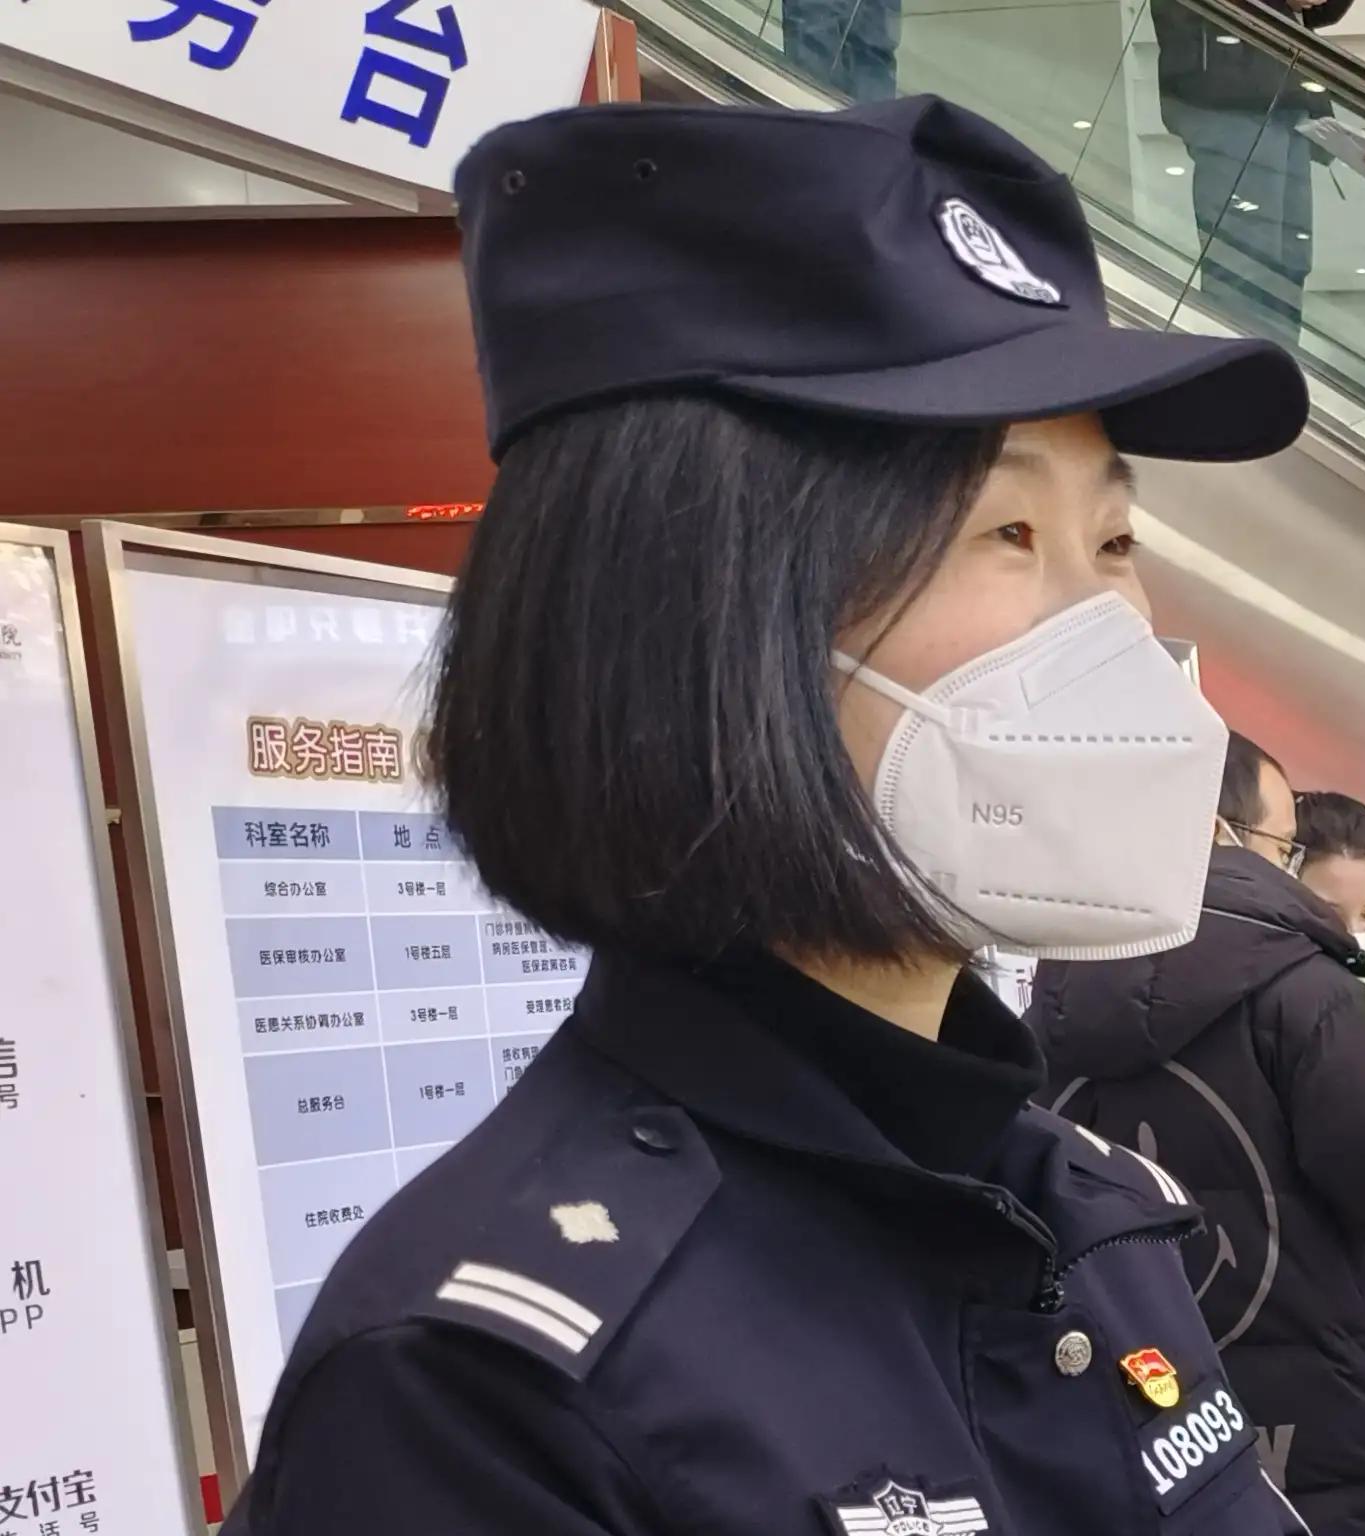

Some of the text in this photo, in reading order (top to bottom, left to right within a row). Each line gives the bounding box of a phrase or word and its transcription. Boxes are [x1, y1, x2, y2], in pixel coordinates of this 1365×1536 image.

[248, 718, 402, 780] 服务指南
[971, 802, 1024, 829] N95
[245, 821, 332, 849] 科室名称
[264, 881, 446, 897] 综合办公室 3号楼一层
[259, 948, 346, 966] 医保审核办公室
[405, 945, 452, 961] 1号楼五层
[255, 1006, 458, 1034] 医患关系协调办公室 3号楼一层
[298, 1083, 465, 1114] 总服务台 1号楼一层
[305, 1204, 365, 1229] 住院收费处
[11, 1260, 51, 1300] 机
[1141, 1390, 1244, 1496] 108093
[0, 1470, 97, 1525] 支付宝
